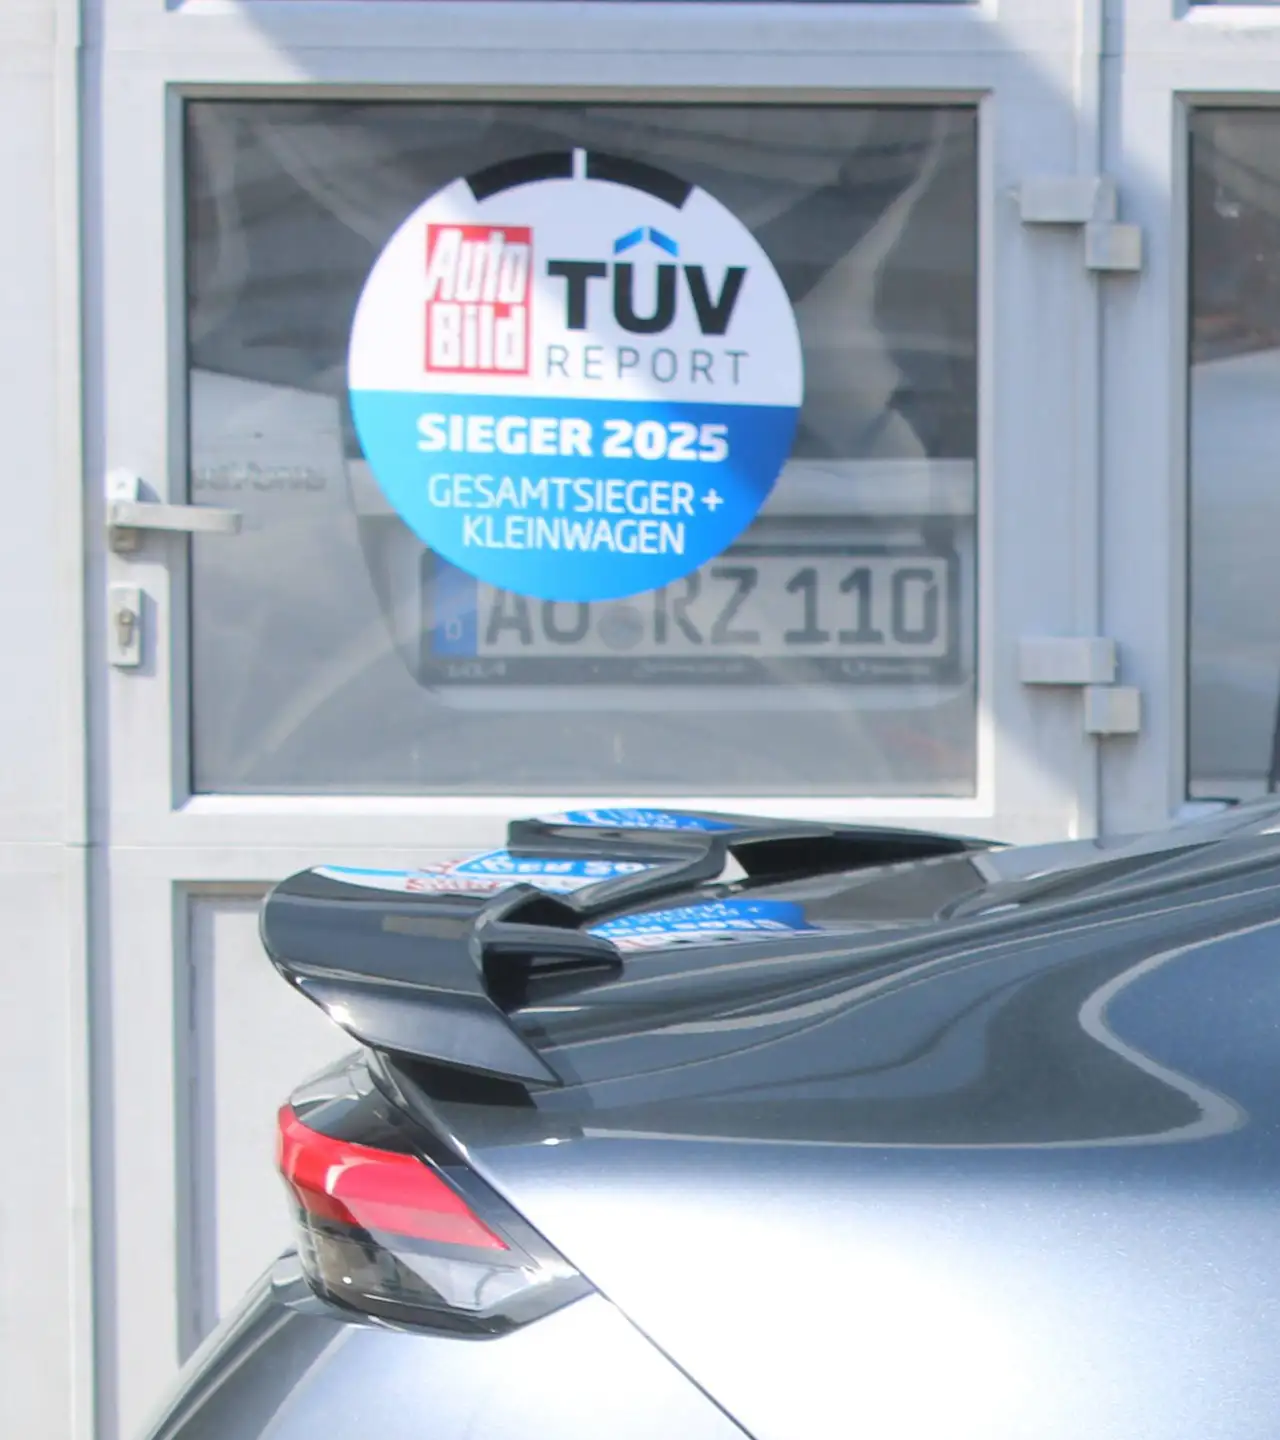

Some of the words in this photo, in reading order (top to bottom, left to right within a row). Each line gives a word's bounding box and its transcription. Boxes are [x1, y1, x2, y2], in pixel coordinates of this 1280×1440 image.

[426, 228, 531, 304] Auto
[429, 302, 529, 372] Bild
[546, 343, 750, 386] REPORT
[415, 412, 593, 458] SIEGER
[602, 418, 730, 463] 2025
[427, 472, 695, 516] GESAMTSIEGER
[701, 487, 725, 512] +
[461, 514, 686, 555] KLEINWAGEN
[654, 566, 760, 646] RZ
[783, 566, 940, 646] 110
